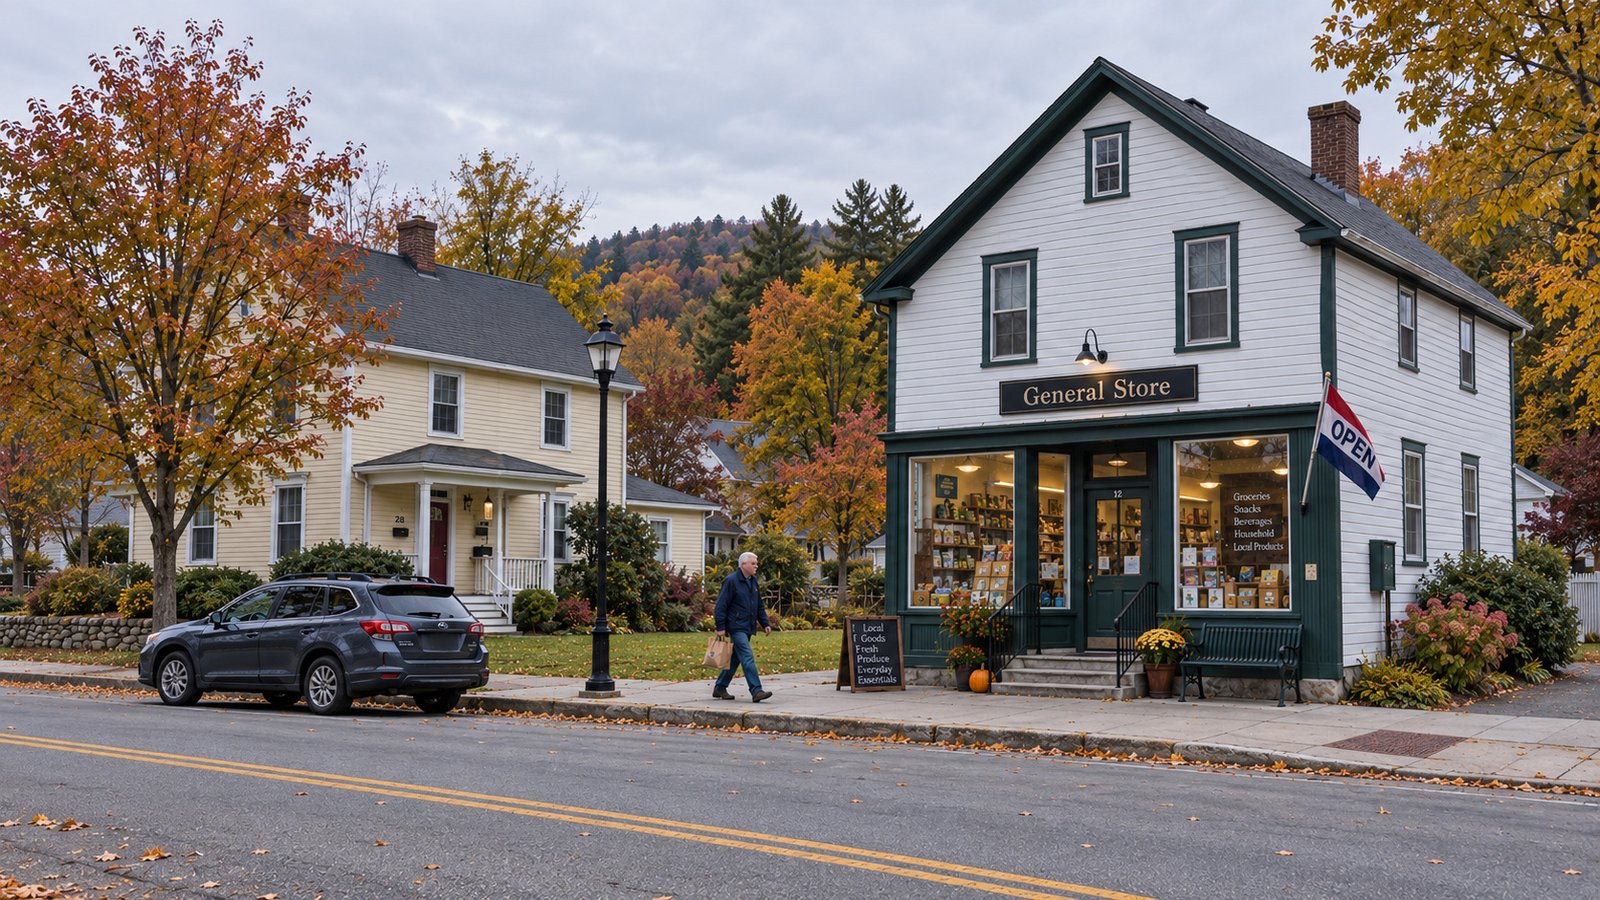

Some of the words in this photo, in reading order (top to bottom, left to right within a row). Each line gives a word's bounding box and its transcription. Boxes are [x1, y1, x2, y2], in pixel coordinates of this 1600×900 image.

[1023, 380, 1105, 406] General
[1114, 378, 1171, 399] Store
[1331, 419, 1376, 470] OPEN
[1113, 489, 1123, 498] 12
[1233, 491, 1271, 501] Groceries
[1233, 504, 1262, 514] Snacks
[395, 515, 405, 523] 28
[1233, 517, 1273, 527] Beverages
[1234, 529, 1275, 538] Household
[1233, 541, 1253, 551] Local
[1253, 541, 1284, 551] Products
[863, 622, 884, 632] Local
[860, 633, 886, 643] Goods
[855, 644, 879, 653] Fresh
[857, 654, 890, 663] Produce
[857, 665, 893, 675] Everyday
[857, 675, 897, 685] Essentials
